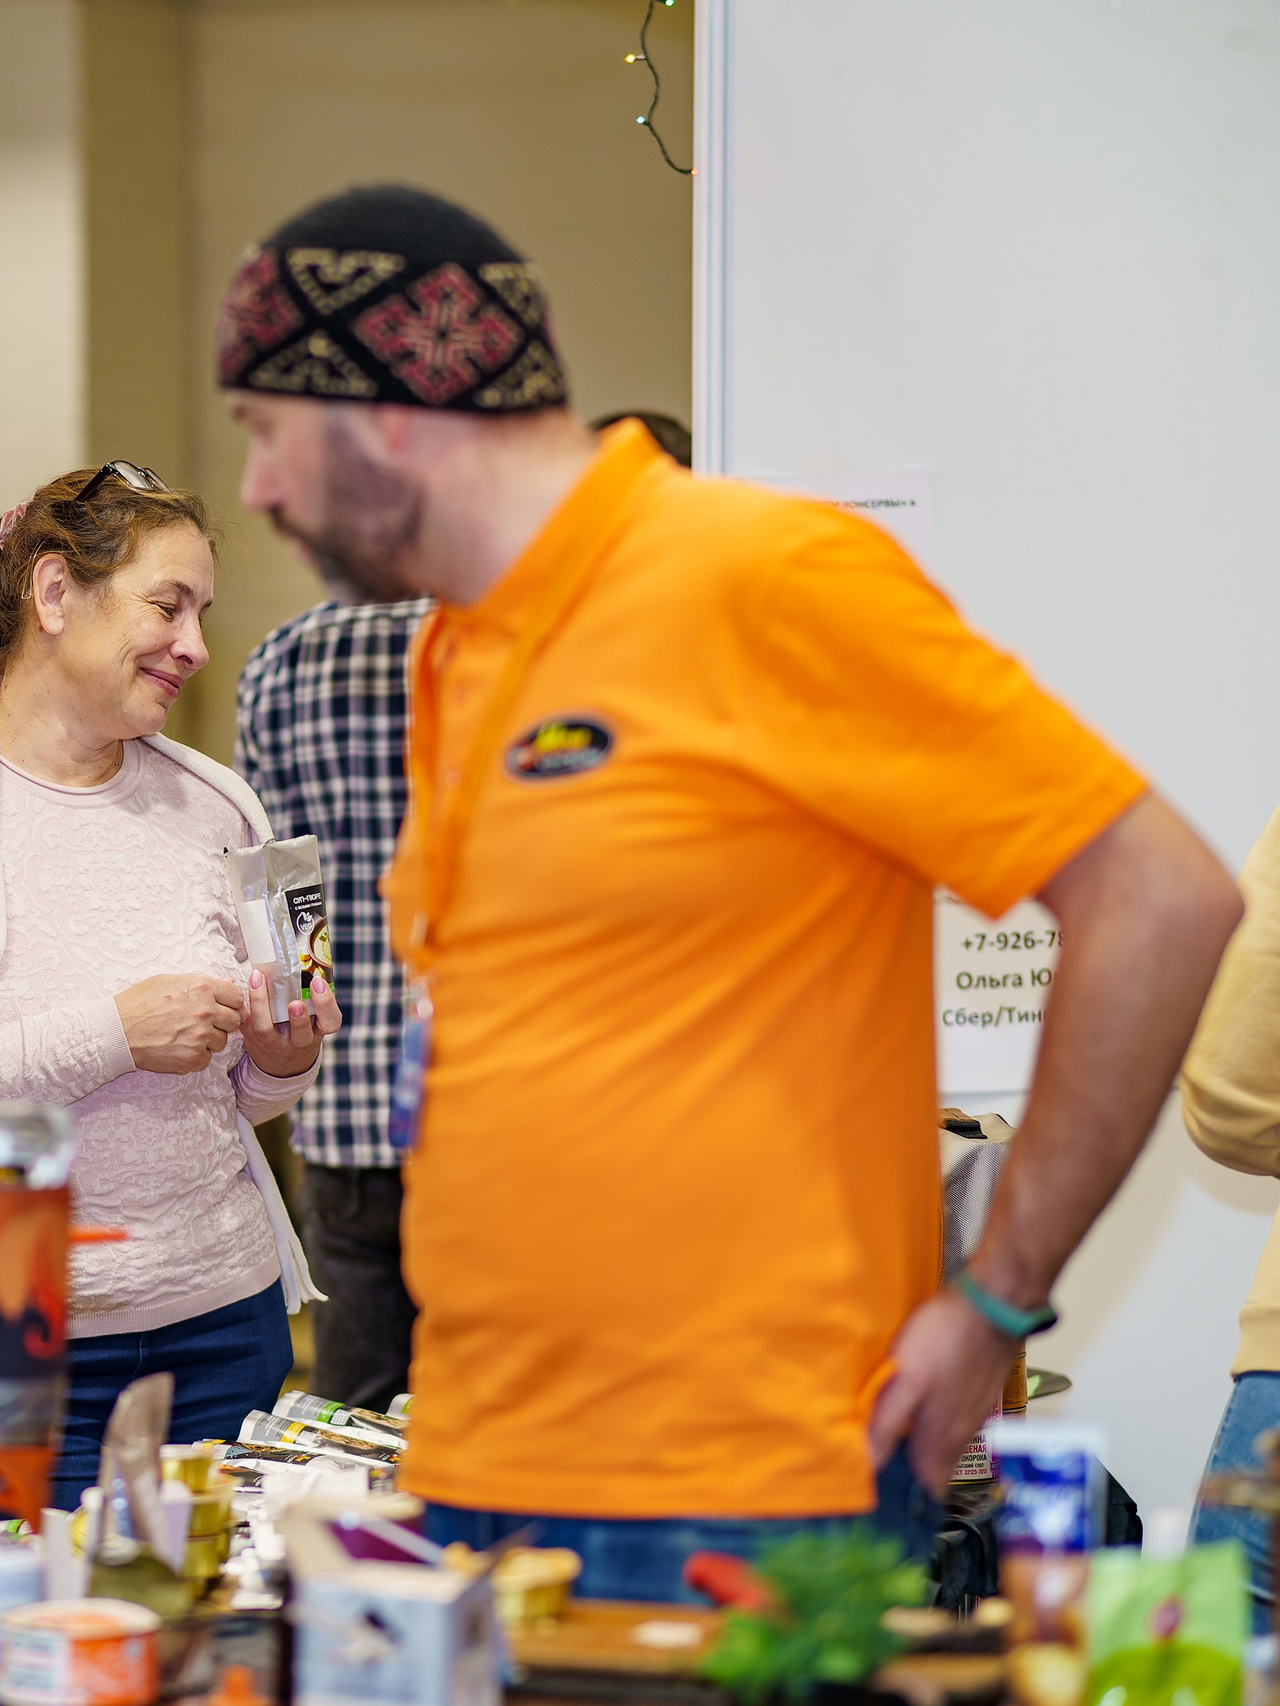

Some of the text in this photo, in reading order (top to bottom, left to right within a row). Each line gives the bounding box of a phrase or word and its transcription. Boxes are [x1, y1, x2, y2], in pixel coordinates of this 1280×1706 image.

[293, 893, 322, 904] СУП-ПЮРЕ
[300, 923, 312, 931] VEG
[956, 971, 1023, 990] Ольга
